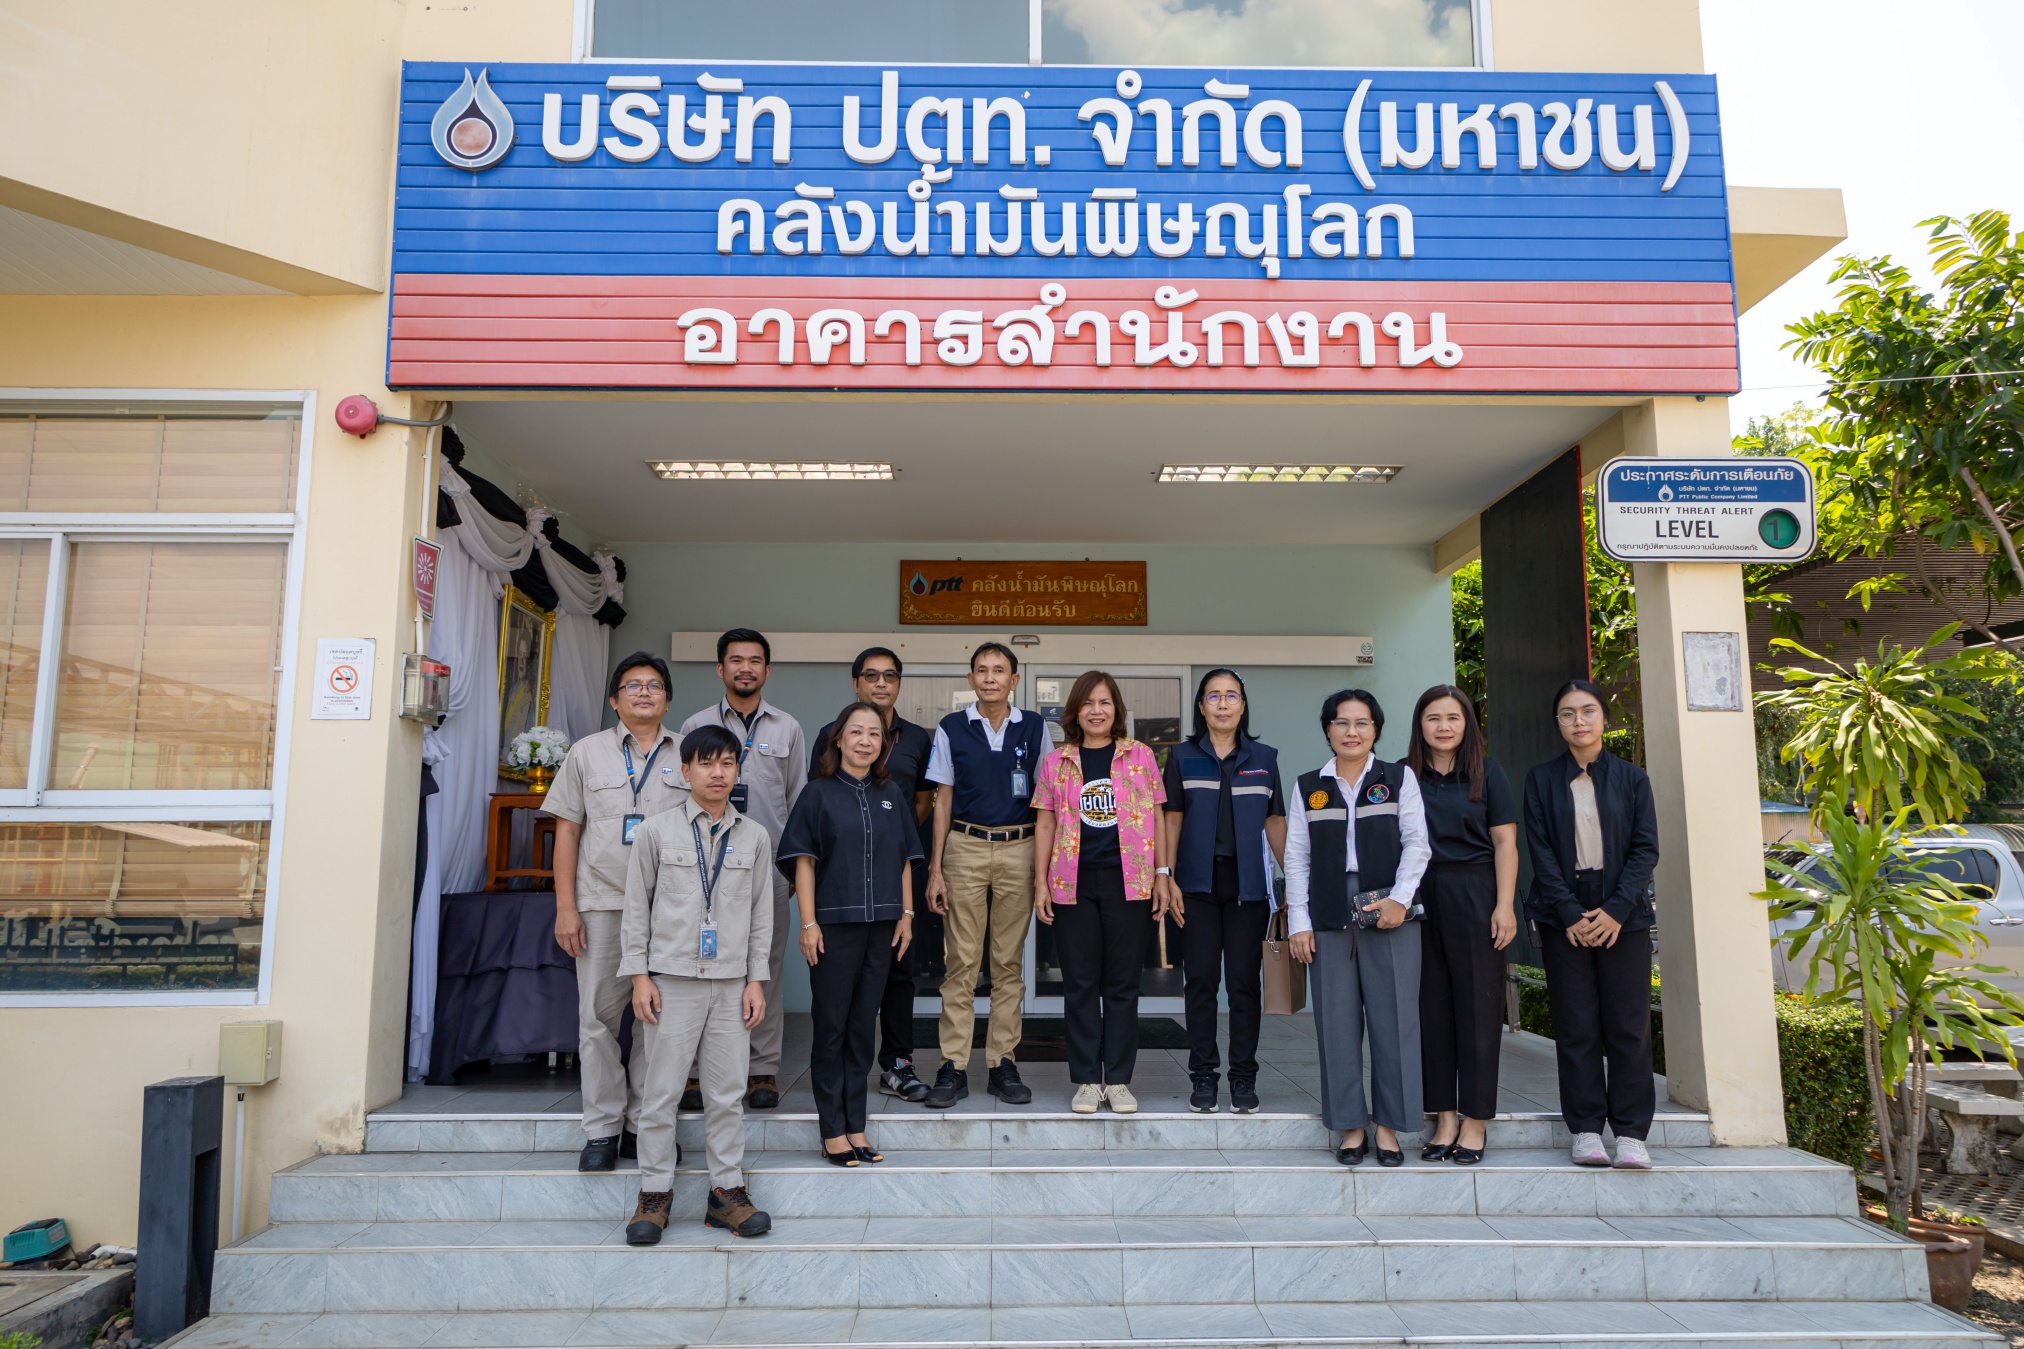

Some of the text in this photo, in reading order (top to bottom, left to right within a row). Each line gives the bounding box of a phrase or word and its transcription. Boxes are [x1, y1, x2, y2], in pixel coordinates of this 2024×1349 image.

[541, 69, 1691, 191] บริษัท ปตท. จำกัด (มหาชน)
[716, 163, 1415, 279] คลังน้ำมันพิษณุโลก
[676, 283, 1464, 368] อาคารสำนักงาน
[1620, 467, 1795, 482] ประกาศระดับการเตือนภัย
[1620, 506, 1755, 516] SECURITY THREAT ALERT
[1655, 519, 1720, 539] LEVEL
[1766, 518, 1780, 541] 1
[929, 575, 964, 596] ptt
[971, 570, 1139, 598] คลังน้ำมันพิษณุโลก
